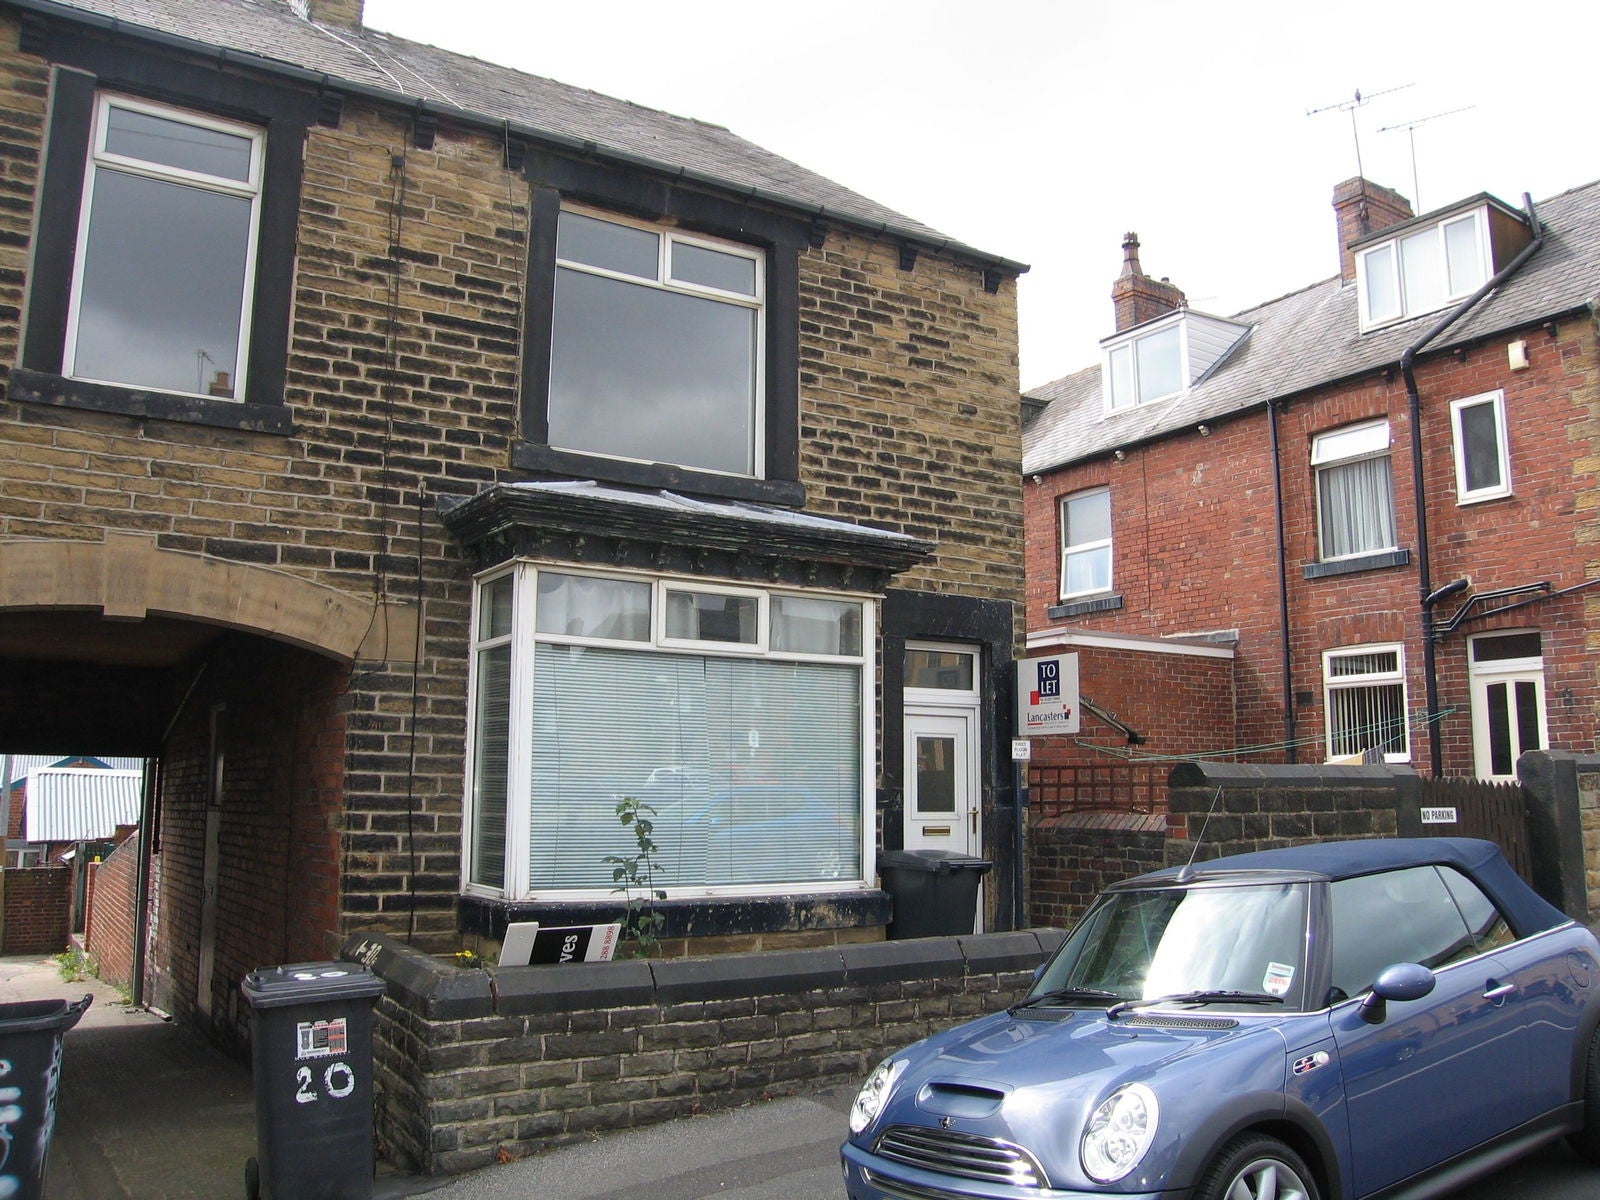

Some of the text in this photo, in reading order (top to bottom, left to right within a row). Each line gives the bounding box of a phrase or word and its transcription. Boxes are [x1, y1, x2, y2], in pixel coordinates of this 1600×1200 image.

[1041, 664, 1056, 678] TO
[1041, 680, 1057, 695] LET
[1027, 711, 1064, 722] Lancasters
[1422, 810, 1454, 820] NO PARKING
[559, 934, 578, 963] ves
[296, 1062, 355, 1104] 20
